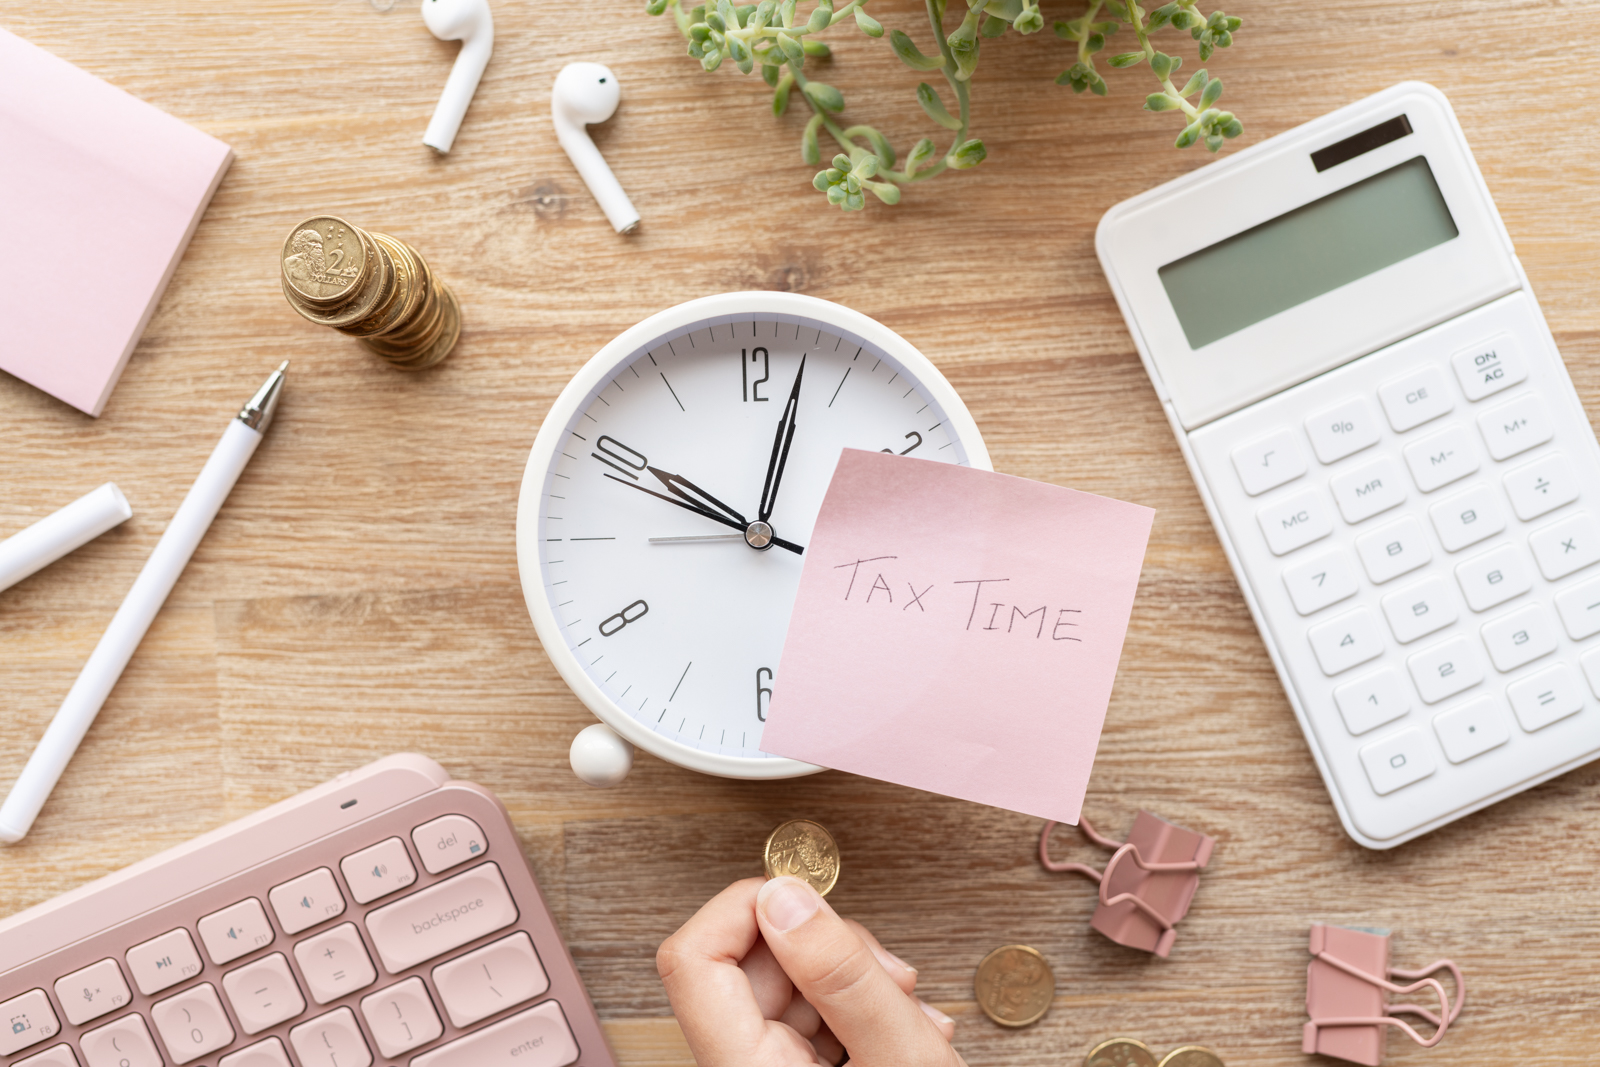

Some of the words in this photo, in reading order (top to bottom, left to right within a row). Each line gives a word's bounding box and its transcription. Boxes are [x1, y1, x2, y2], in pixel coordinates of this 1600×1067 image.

[325, 249, 345, 275] 2
[311, 274, 348, 286] DOLLARS
[1474, 350, 1497, 366] ON
[742, 346, 769, 402] 12
[1484, 368, 1504, 384] AC
[1405, 388, 1428, 405] CE
[591, 435, 648, 481] 10
[1356, 480, 1382, 496] MR
[1282, 511, 1309, 528] MC
[1461, 510, 1476, 524] 9
[1386, 542, 1402, 556] 8
[1312, 572, 1326, 586] 7
[1487, 570, 1503, 584] 6
[833, 556, 934, 612] TAX
[954, 578, 1082, 642] TIME
[1412, 602, 1428, 616] 5
[599, 600, 649, 637] 8
[1340, 634, 1354, 646] 4
[1513, 631, 1529, 645] 3
[1438, 662, 1455, 677] 2
[756, 667, 773, 722] 6
[1369, 694, 1378, 705] 1
[1390, 754, 1406, 768] 0
[437, 833, 458, 851] del
[397, 873, 411, 884] ins
[325, 903, 340, 915] F12
[411, 898, 484, 935] backspace
[254, 934, 268, 946] F11
[181, 964, 197, 977] F10
[111, 994, 123, 1006] F9
[39, 1025, 52, 1036] F8
[510, 1035, 545, 1057] enter
